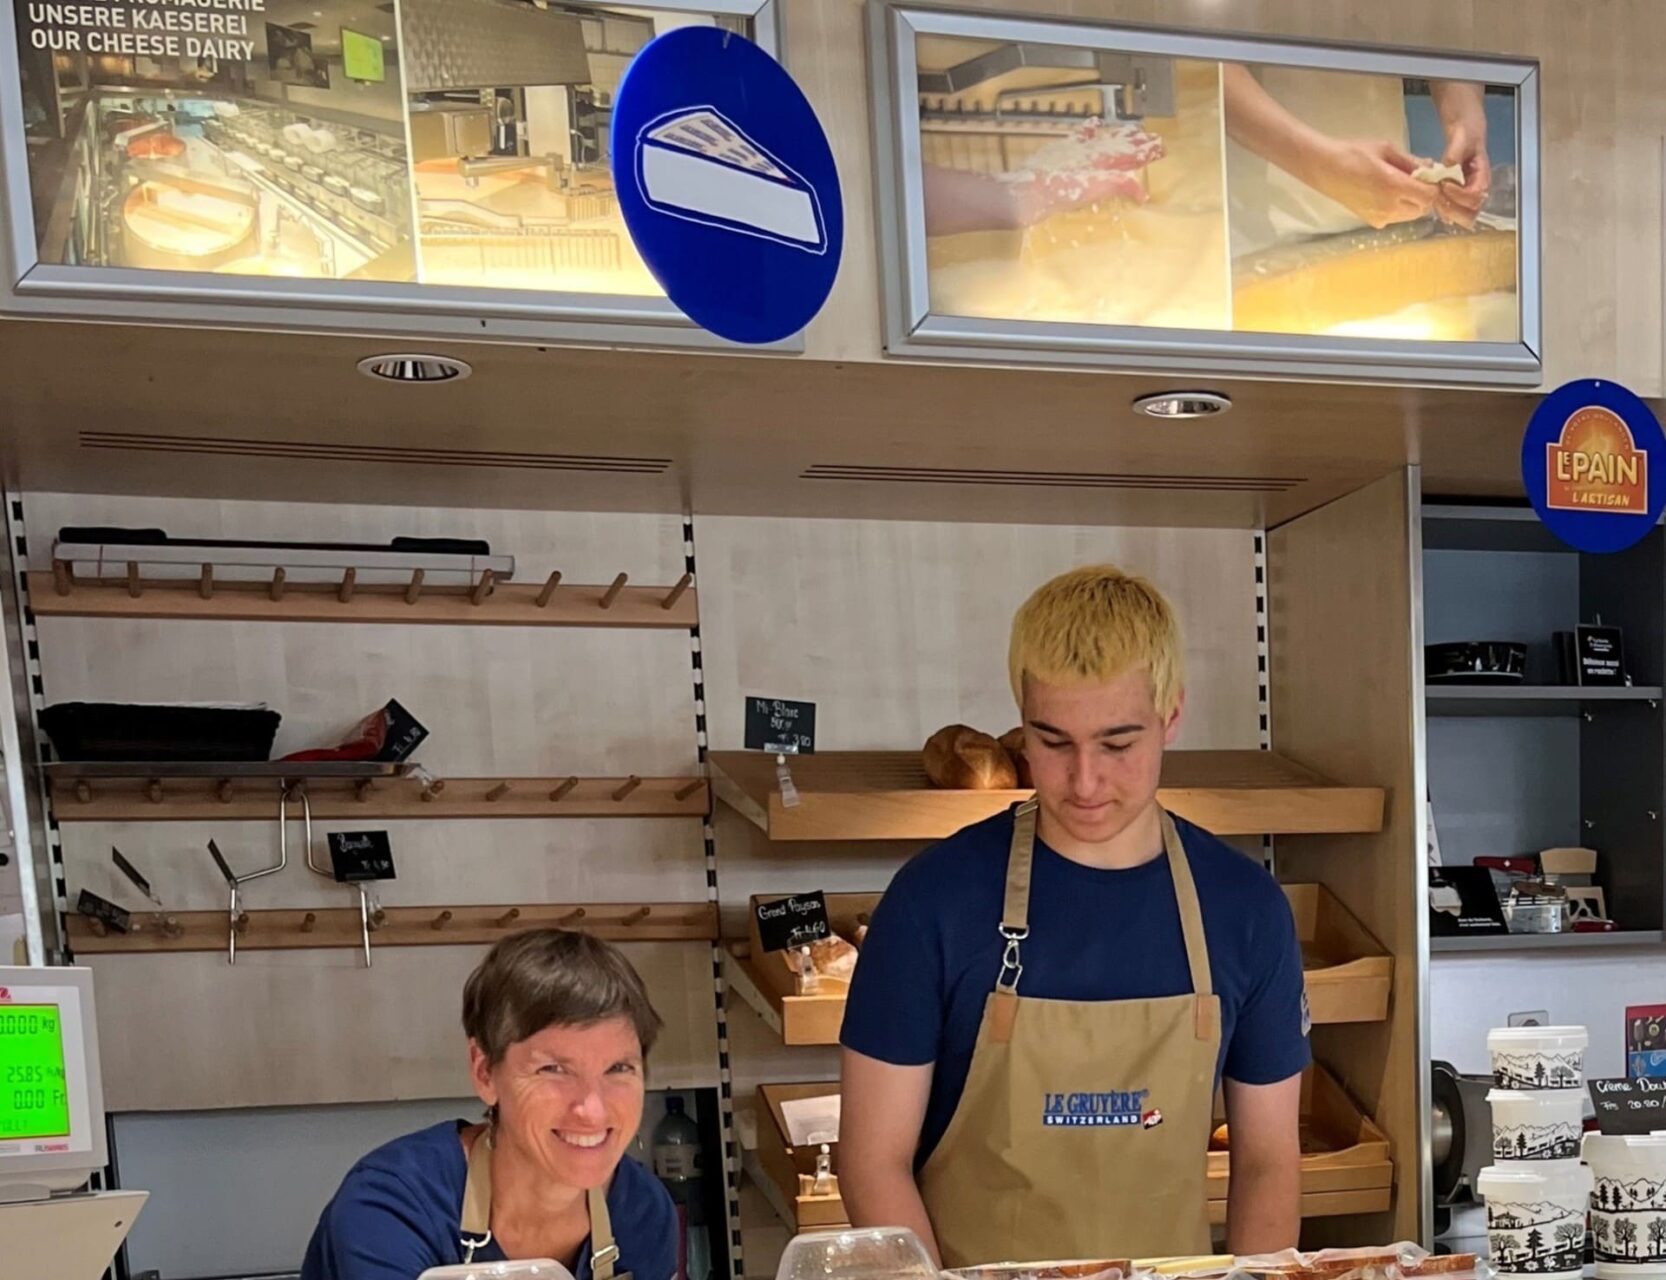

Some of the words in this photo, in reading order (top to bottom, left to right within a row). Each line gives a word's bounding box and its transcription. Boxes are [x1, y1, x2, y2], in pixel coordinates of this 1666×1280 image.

[29, 3, 126, 28] UNSERE
[132, 9, 247, 35] KAESEREI
[31, 29, 80, 51] OUR
[87, 32, 180, 56] CHEESE
[186, 37, 254, 60] DAIRY
[1573, 452, 1637, 485] PAIN
[42, 1018, 55, 1032] kg
[1044, 1093, 1064, 1114] LE
[1047, 1115, 1138, 1124] SWITZERLAND
